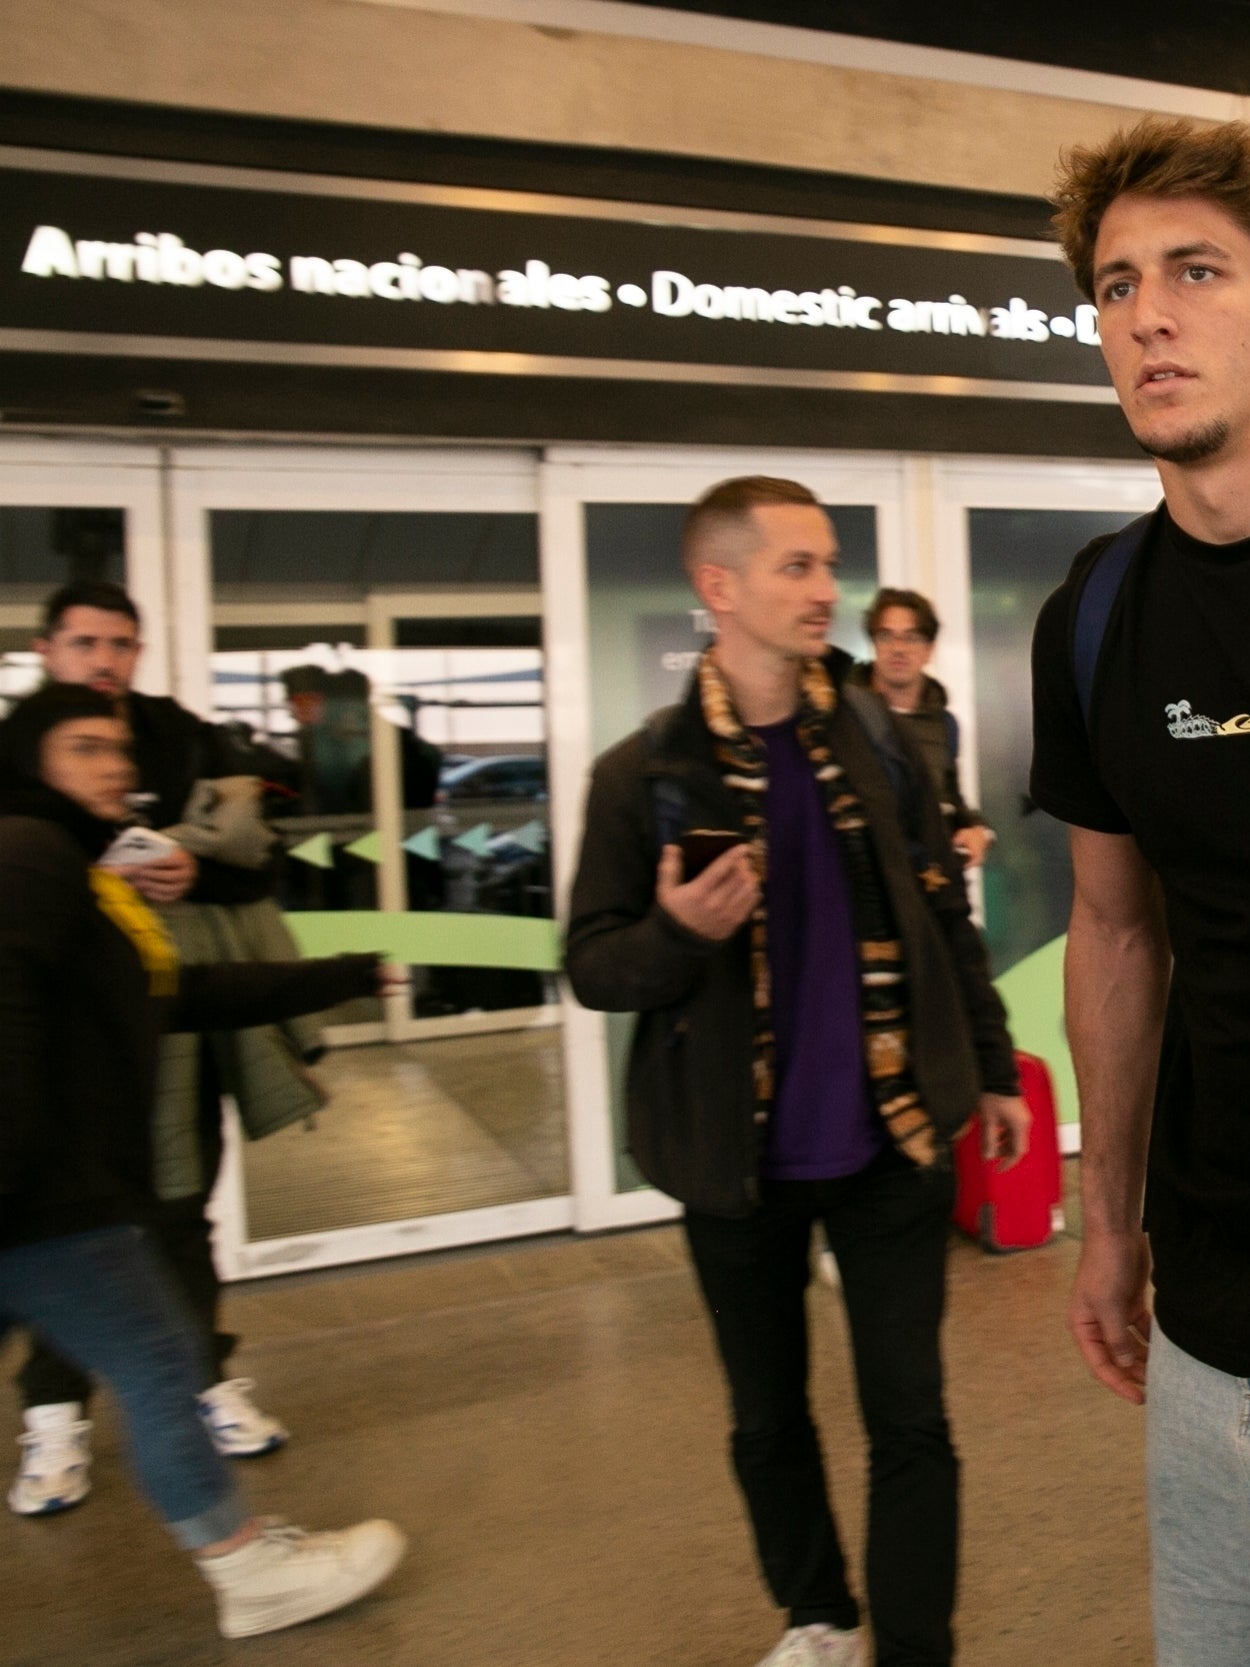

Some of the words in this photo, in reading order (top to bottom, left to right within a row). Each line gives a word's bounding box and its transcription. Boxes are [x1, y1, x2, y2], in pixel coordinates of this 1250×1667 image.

[21, 225, 283, 291] Arribos
[290, 252, 613, 312] nacionales
[651, 270, 883, 330] Domestic
[887, 294, 1051, 343] arrivals
